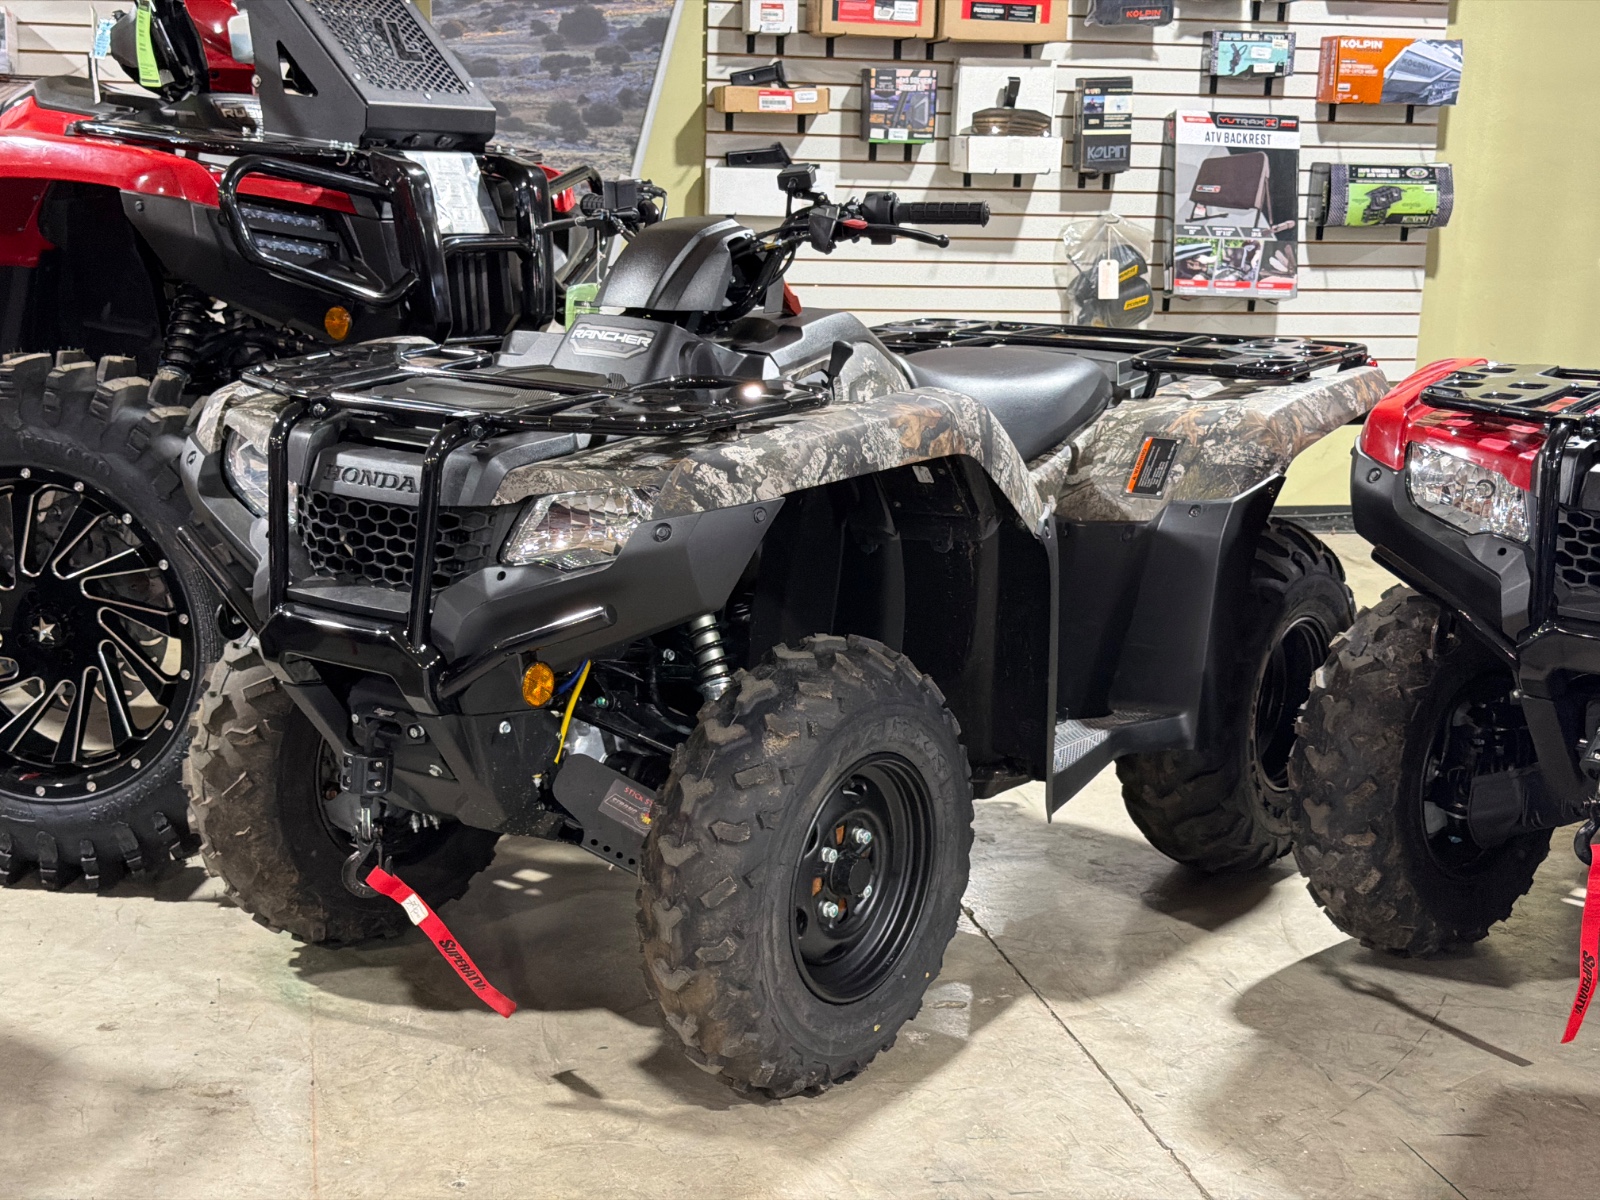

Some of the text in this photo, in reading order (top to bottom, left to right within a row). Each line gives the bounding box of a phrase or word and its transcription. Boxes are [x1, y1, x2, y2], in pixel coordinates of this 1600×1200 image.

[1126, 9, 1162, 17] KOLPIN
[1340, 39, 1384, 49] KOLPIN
[1205, 131, 1272, 145] ATV BACKREST
[571, 328, 653, 348] RANCHER
[1133, 448, 1148, 475] WARNING
[323, 463, 420, 493] HONDA
